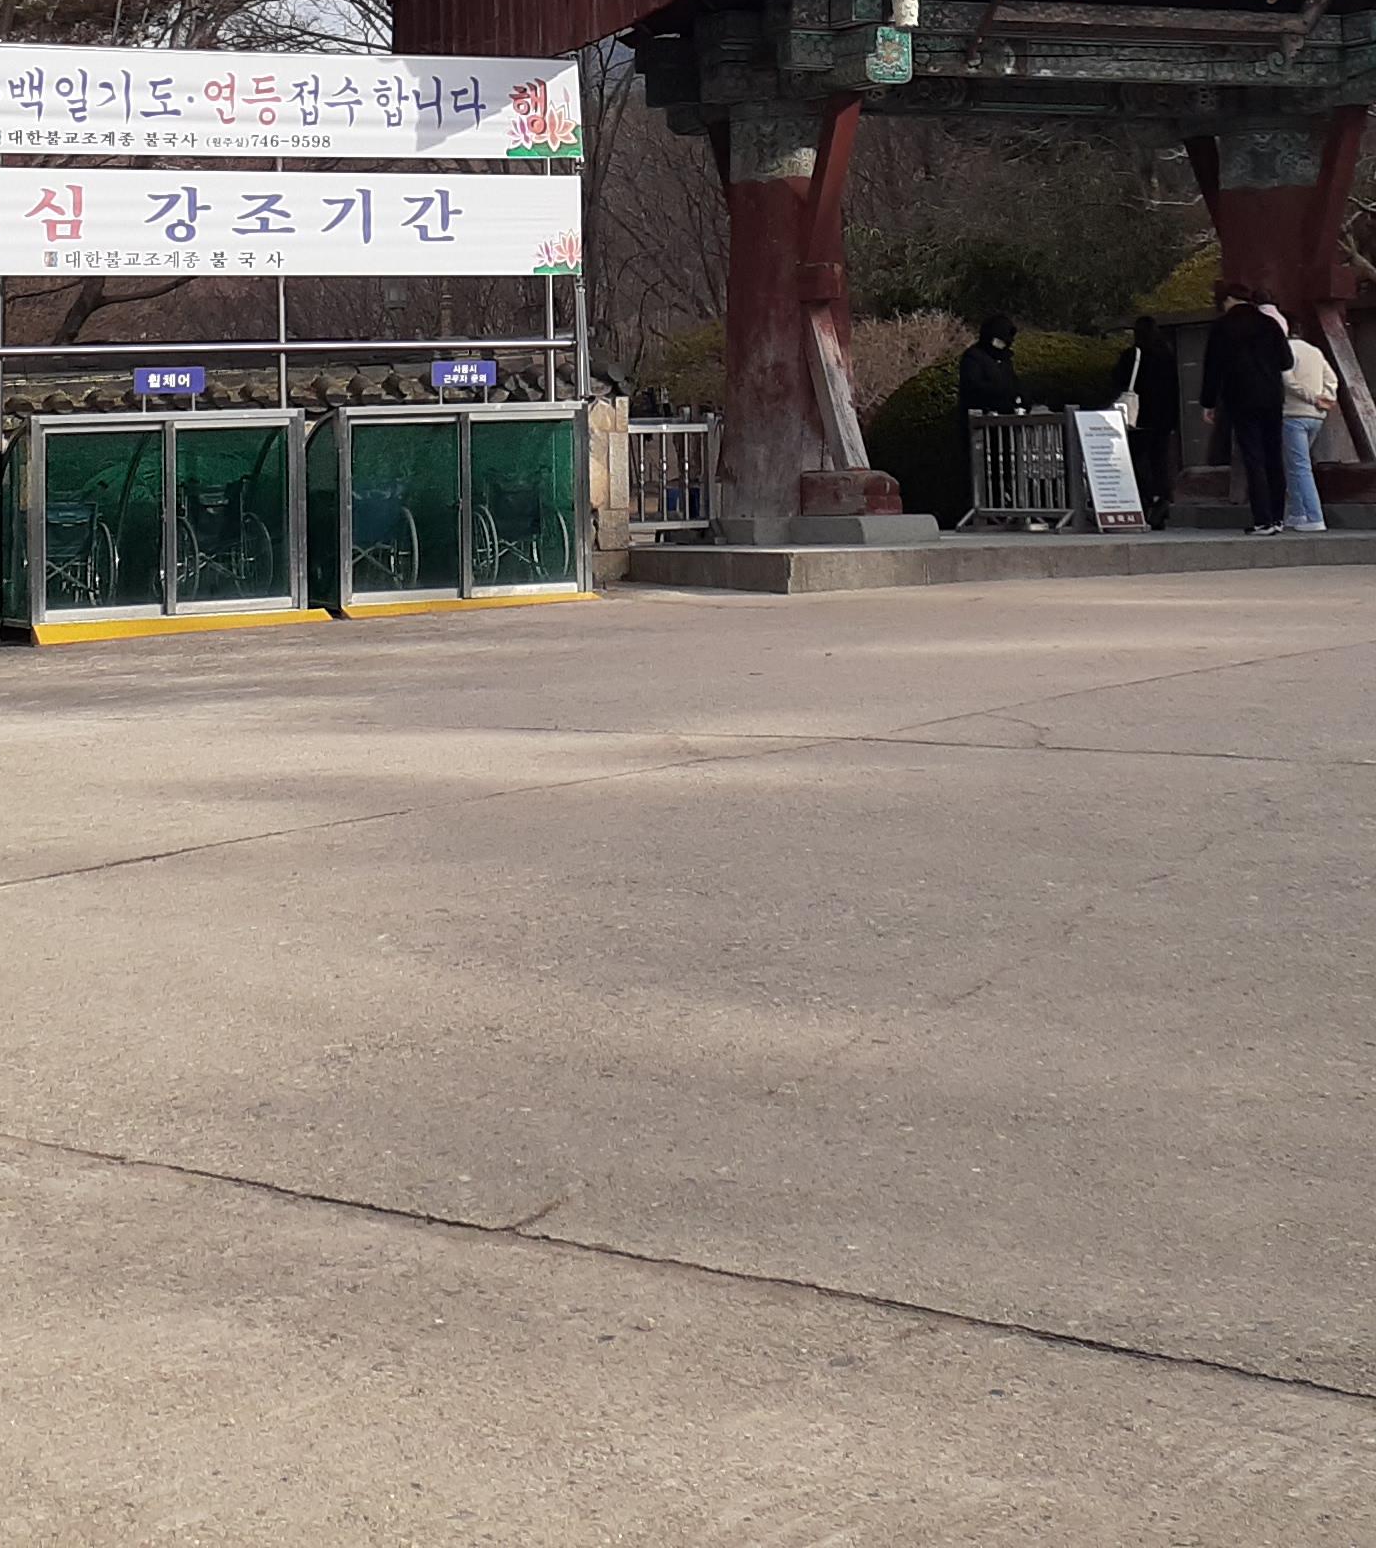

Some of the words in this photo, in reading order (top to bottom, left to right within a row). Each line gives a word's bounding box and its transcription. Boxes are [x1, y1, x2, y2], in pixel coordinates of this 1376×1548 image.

[509, 78, 547, 135] 행
[8, 130, 135, 146] 대한불교조계종
[143, 132, 198, 147] 불국사
[65, 251, 200, 268] 대한불교조계종
[148, 373, 190, 388] 휠체어
